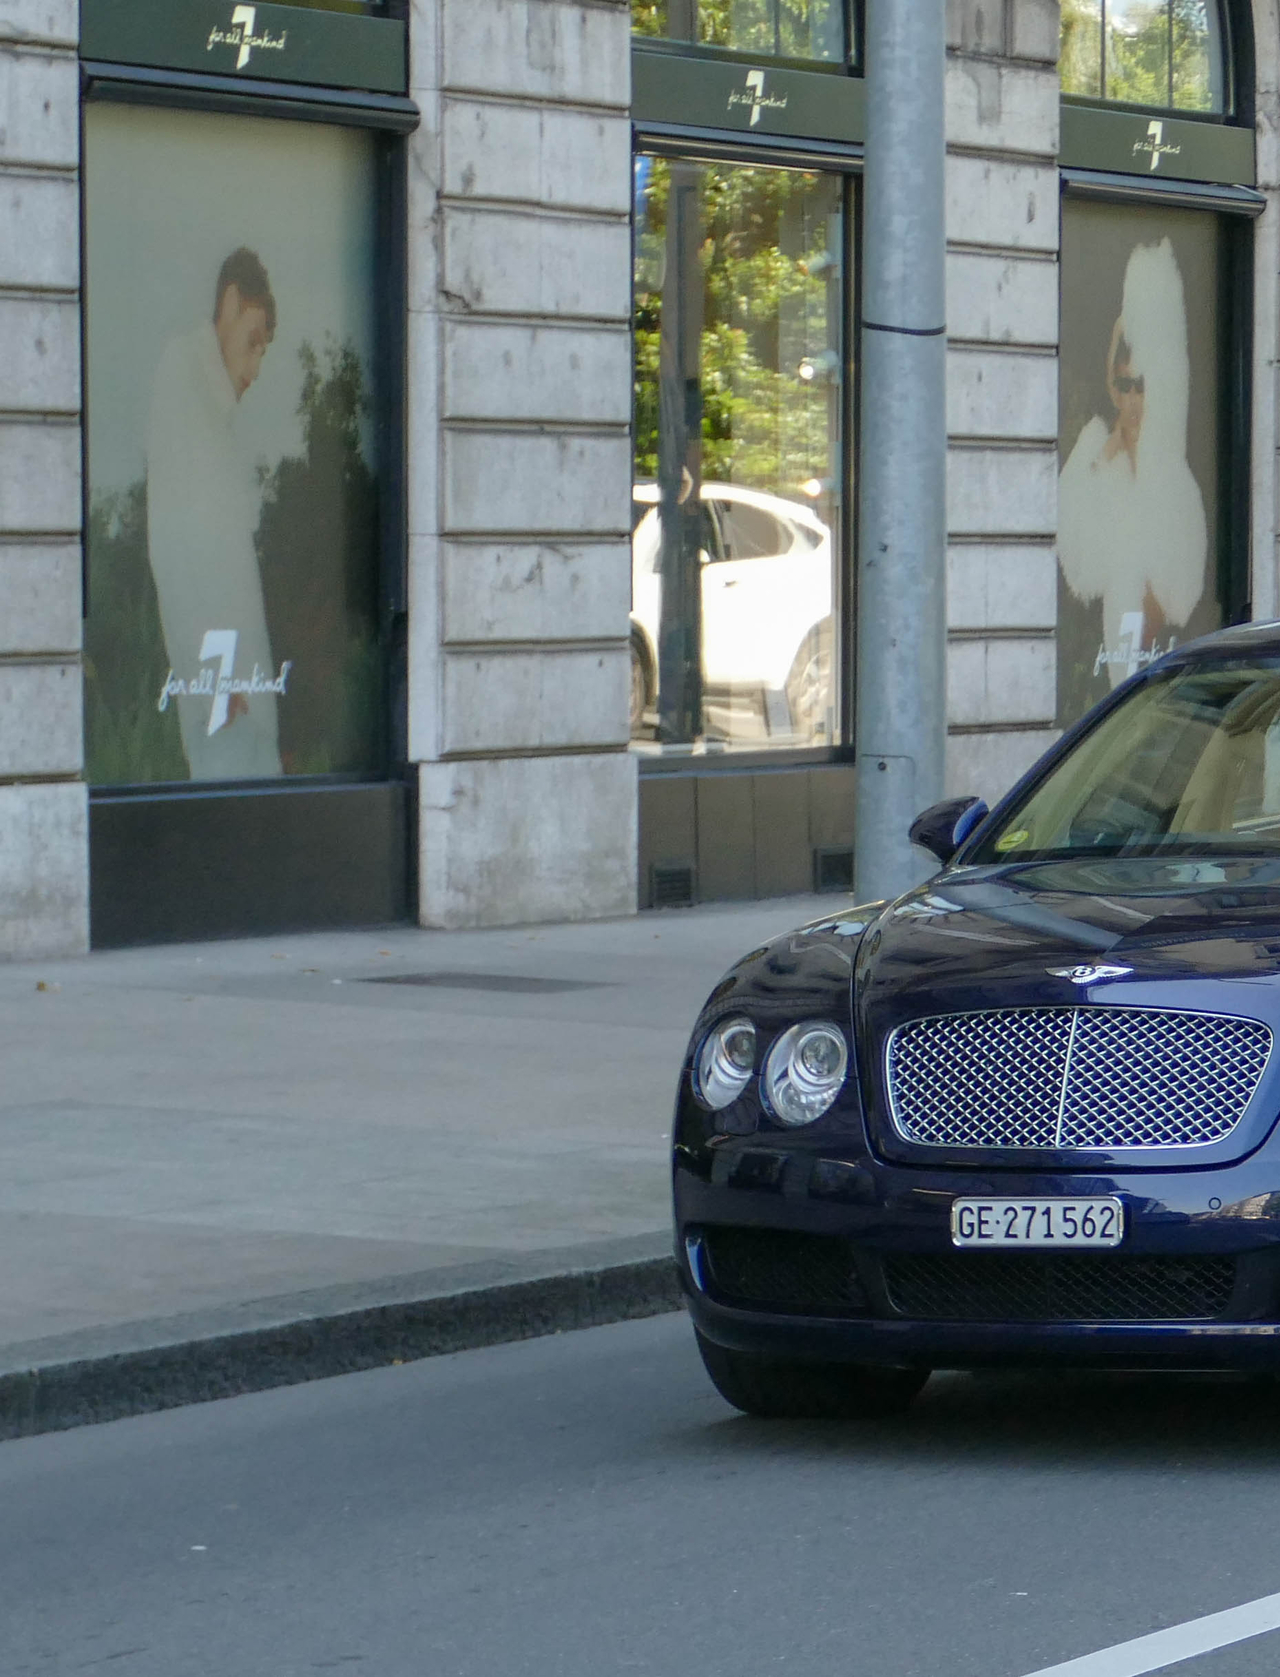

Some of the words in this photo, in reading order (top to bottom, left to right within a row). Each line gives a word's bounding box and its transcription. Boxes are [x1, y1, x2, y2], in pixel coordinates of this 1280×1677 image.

[231, 4, 256, 70] 7
[745, 69, 765, 127] 7
[1147, 120, 1163, 171] 7
[158, 667, 187, 712] for
[189, 668, 215, 695] all
[217, 661, 293, 695] mankind
[199, 629, 239, 736] 7
